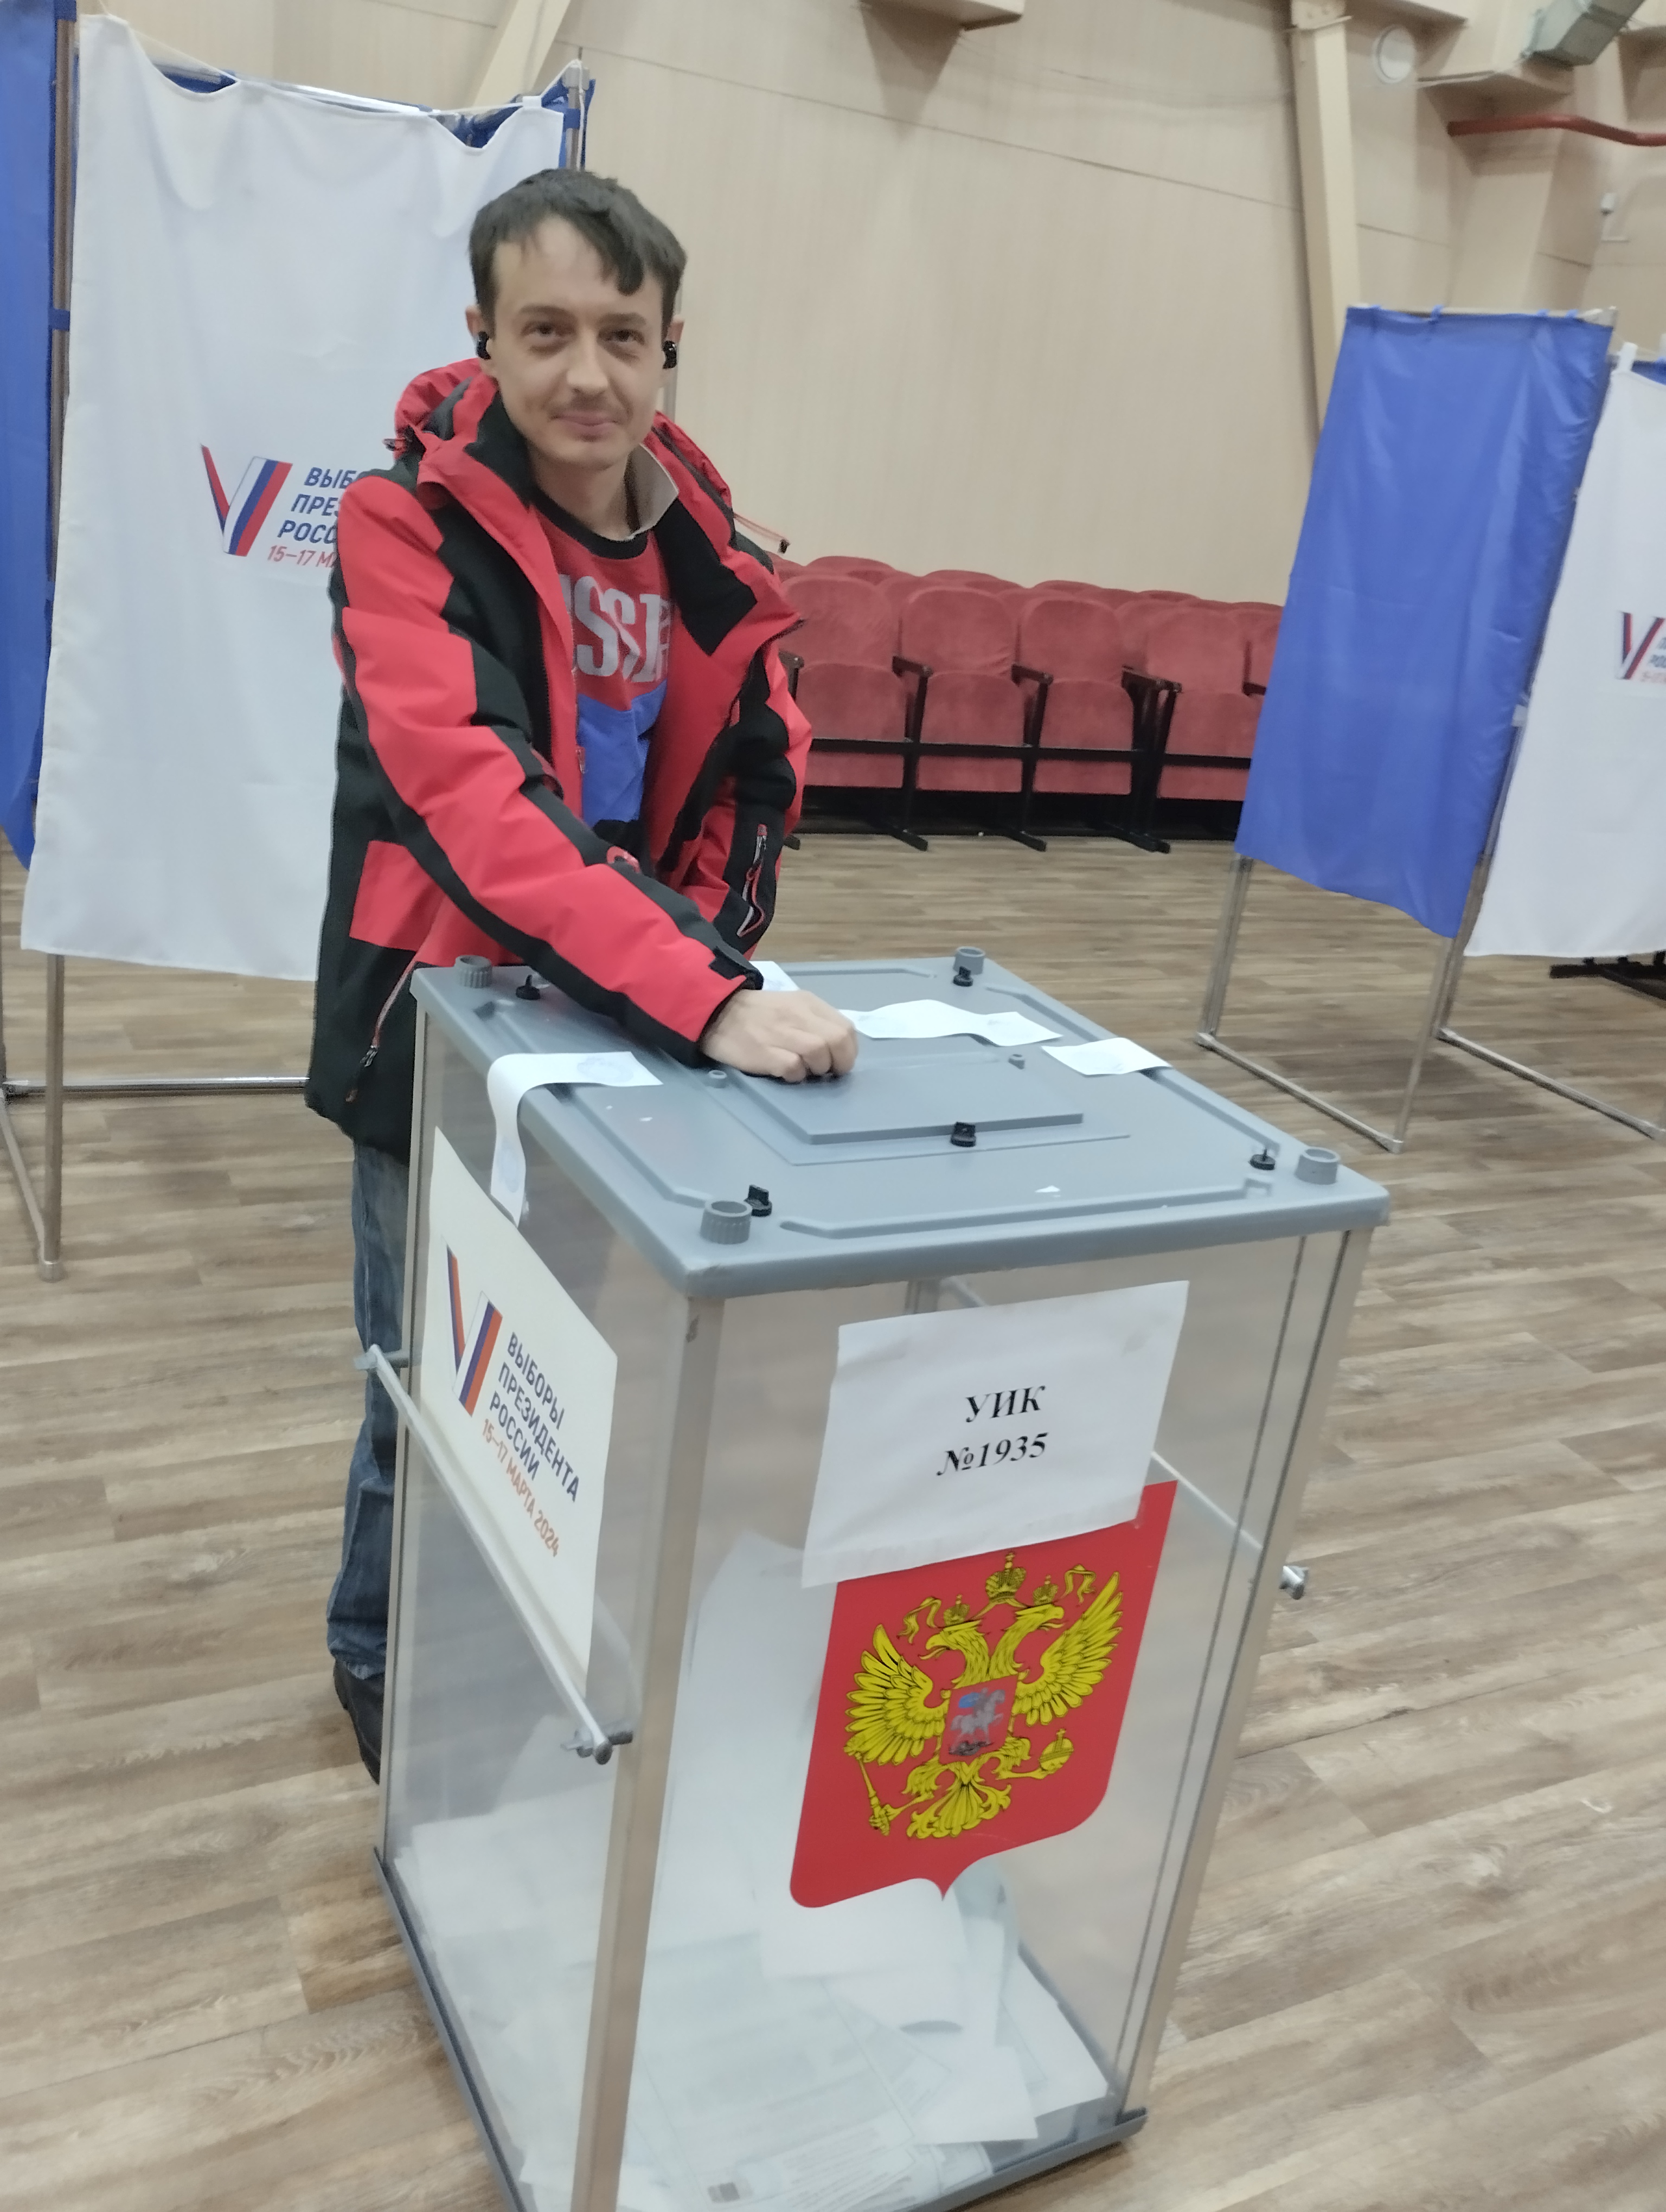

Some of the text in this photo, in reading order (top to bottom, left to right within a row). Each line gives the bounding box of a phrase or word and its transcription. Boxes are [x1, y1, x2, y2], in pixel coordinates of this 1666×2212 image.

[304, 467, 357, 489] ВЫБ
[277, 520, 337, 544] РОСС
[508, 1332, 565, 1430] ВЫБОРЫ
[965, 1385, 1046, 1423] УИК
[490, 1391, 540, 1481] РОССИИ
[498, 1361, 579, 1502] ПРЕЗИДЕНТА
[936, 1432, 1049, 1476] №1935
[506, 1457, 535, 1518] МАРТА
[534, 1509, 559, 1557] 2024
